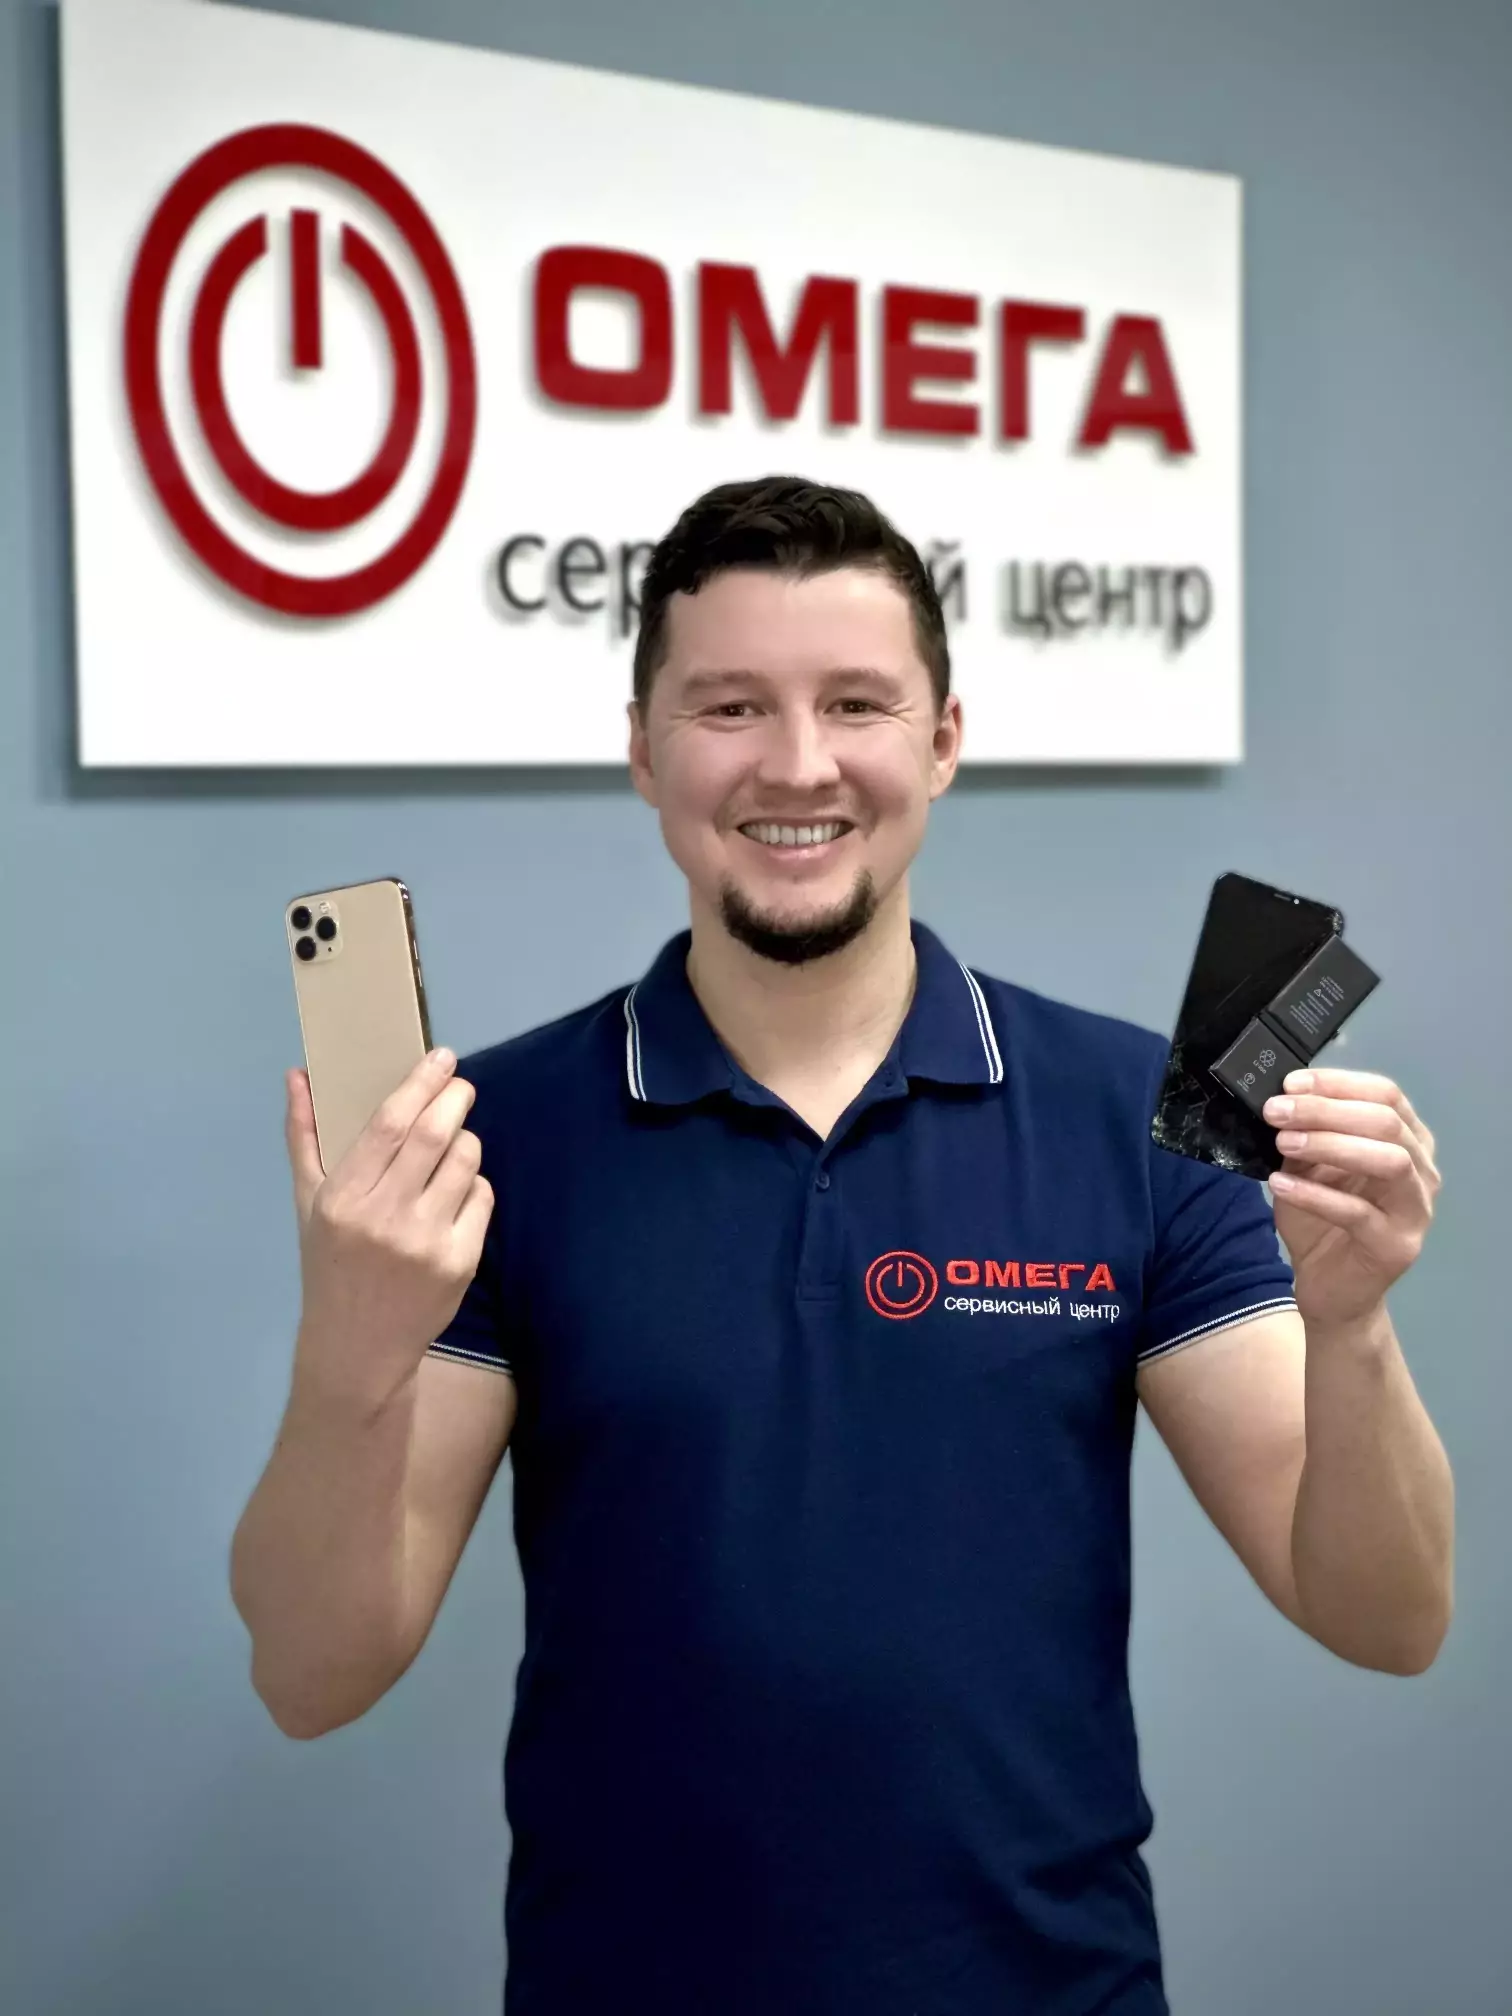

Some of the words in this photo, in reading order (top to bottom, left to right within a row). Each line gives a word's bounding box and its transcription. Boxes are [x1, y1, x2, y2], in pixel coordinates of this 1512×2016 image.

[533, 244, 1197, 456] ОМЕГА
[1007, 557, 1214, 654] центр
[946, 1259, 1117, 1292] ОМЕГА
[944, 1296, 1061, 1316] сервисный
[1069, 1301, 1121, 1324] центр
